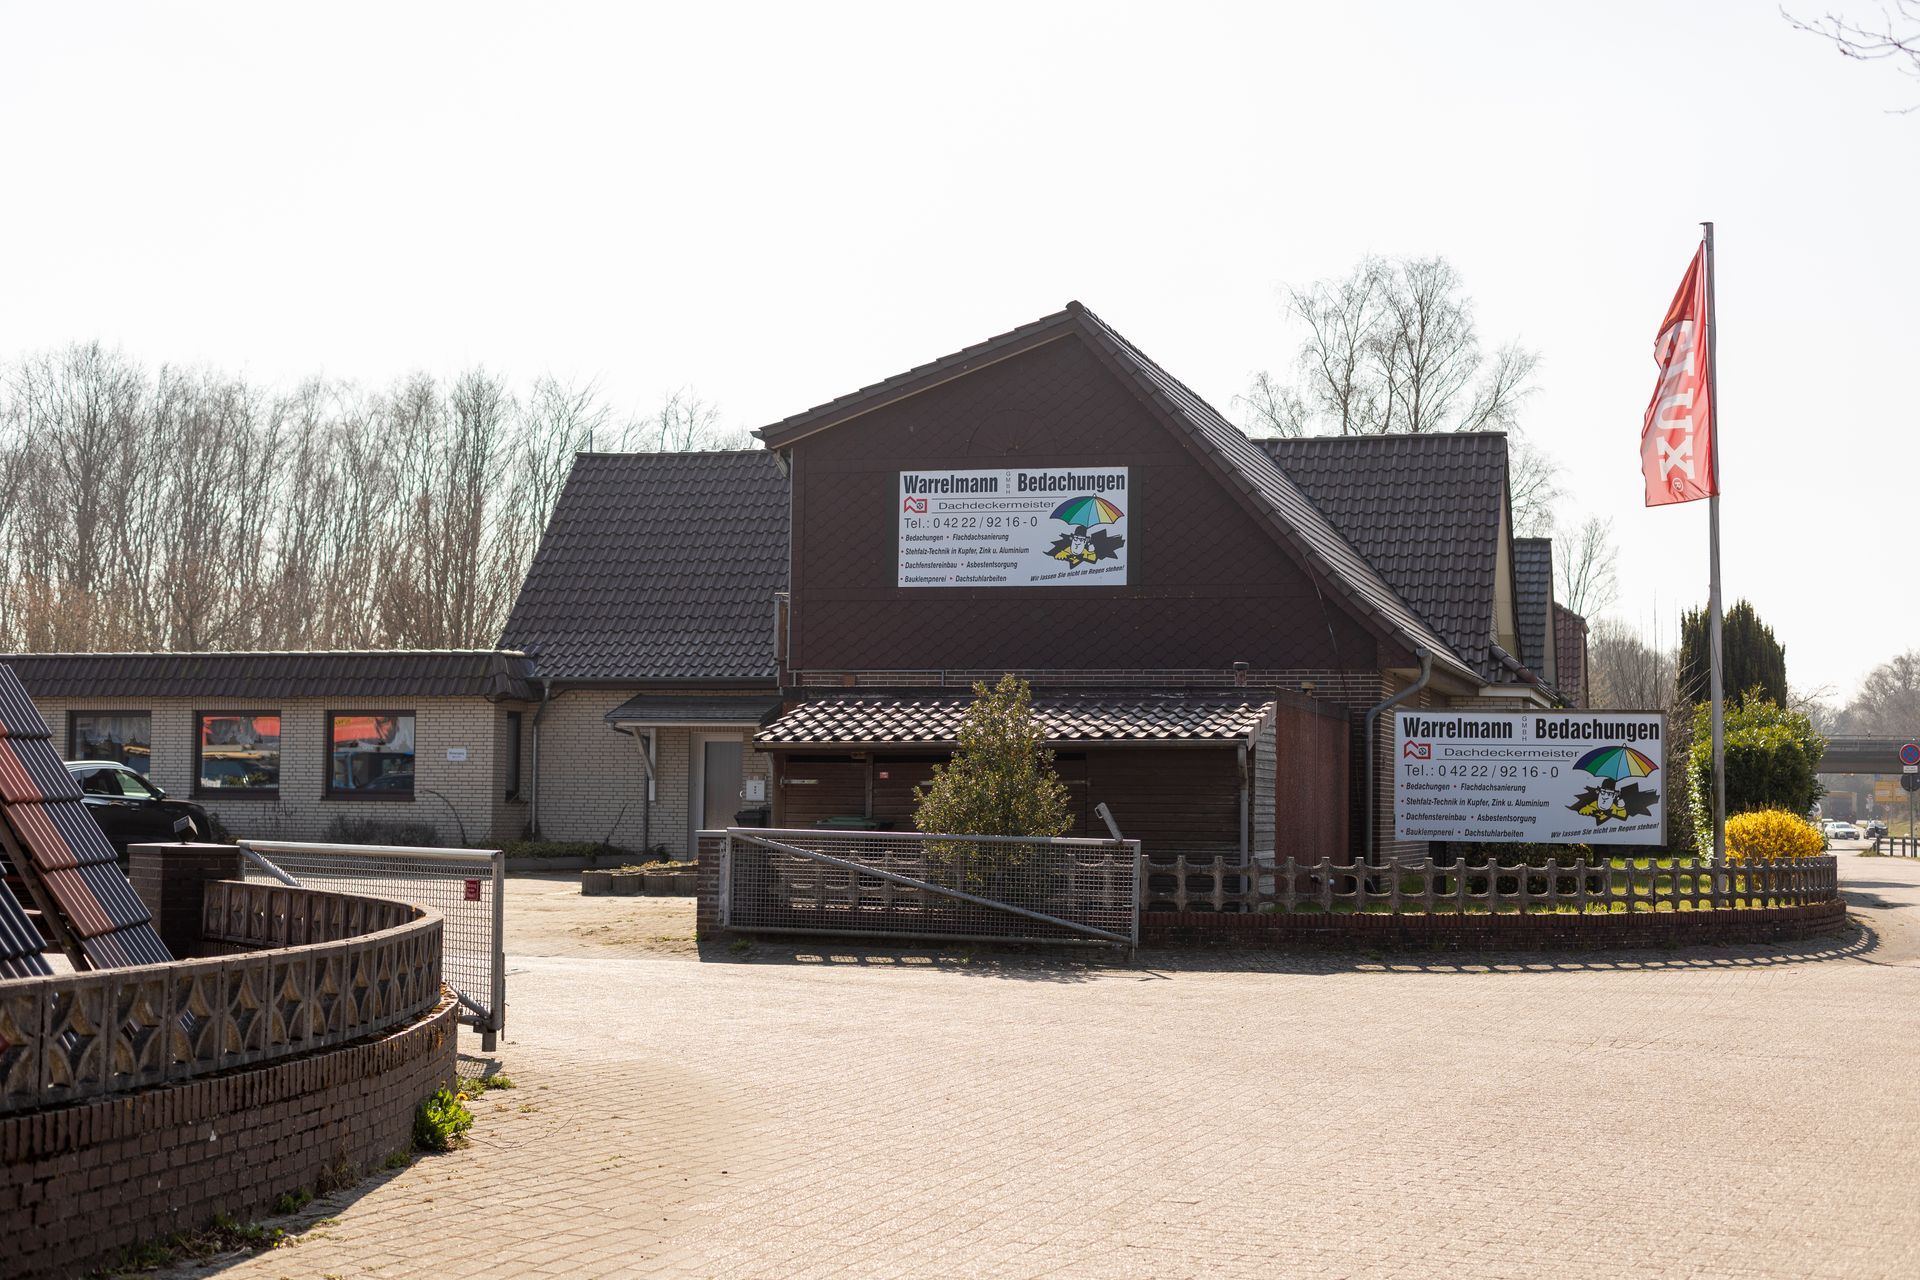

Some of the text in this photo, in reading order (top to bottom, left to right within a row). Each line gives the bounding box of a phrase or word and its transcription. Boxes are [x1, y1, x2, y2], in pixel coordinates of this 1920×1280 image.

[904, 475, 998, 494] Warrelmann
[1017, 472, 1125, 493] Bedachungen
[938, 500, 1055, 510] Dachdeckermeister
[904, 517, 930, 529] Tel.:
[933, 517, 940, 528] 0
[943, 517, 958, 528] 42
[961, 517, 976, 528] 22
[986, 516, 1001, 528] 92
[1006, 516, 1020, 527] 16
[1030, 516, 1038, 527] 0
[905, 534, 944, 542] Bedachungen
[952, 533, 1009, 541] Flachdachsanierung
[905, 547, 950, 555] Stehfalz-Technik
[979, 547, 991, 555] Zink
[905, 561, 957, 569] Dachfenstereinbau
[966, 561, 1018, 570] Asbestentsorgung
[904, 575, 947, 584] Bauklempnerei
[955, 574, 1007, 583] Dachstuhlarbeiten
[1403, 717, 1513, 739] Warrelmann
[1535, 718, 1660, 742] Bedachungen
[1444, 747, 1579, 758] Dachdeckermeister
[1404, 764, 1434, 777] Tel.:
[1438, 765, 1446, 777] 0
[1450, 765, 1467, 777] 42
[1471, 765, 1488, 777] 22
[1500, 765, 1517, 777] 92
[1522, 765, 1538, 778] 16
[1550, 766, 1559, 778] 0
[1406, 783, 1450, 792] Bedachungen
[1460, 783, 1526, 793] Flachdachsanierung
[1406, 797, 1458, 806] Stehfalz-Technik
[1459, 798, 1465, 806] in
[1467, 798, 1490, 808] Kupfer,
[1491, 798, 1506, 806] Zink
[1515, 799, 1550, 807] Aluminium
[1406, 812, 1467, 821] Dachfenstereinbau
[1476, 814, 1537, 824] Asbestentsorgung
[1405, 828, 1454, 837] Bauklempnerei
[1464, 828, 1524, 838] Dachstuhlarbeiten
[1592, 827, 1608, 835] nicht
[1637, 822, 1660, 830] stehen!
